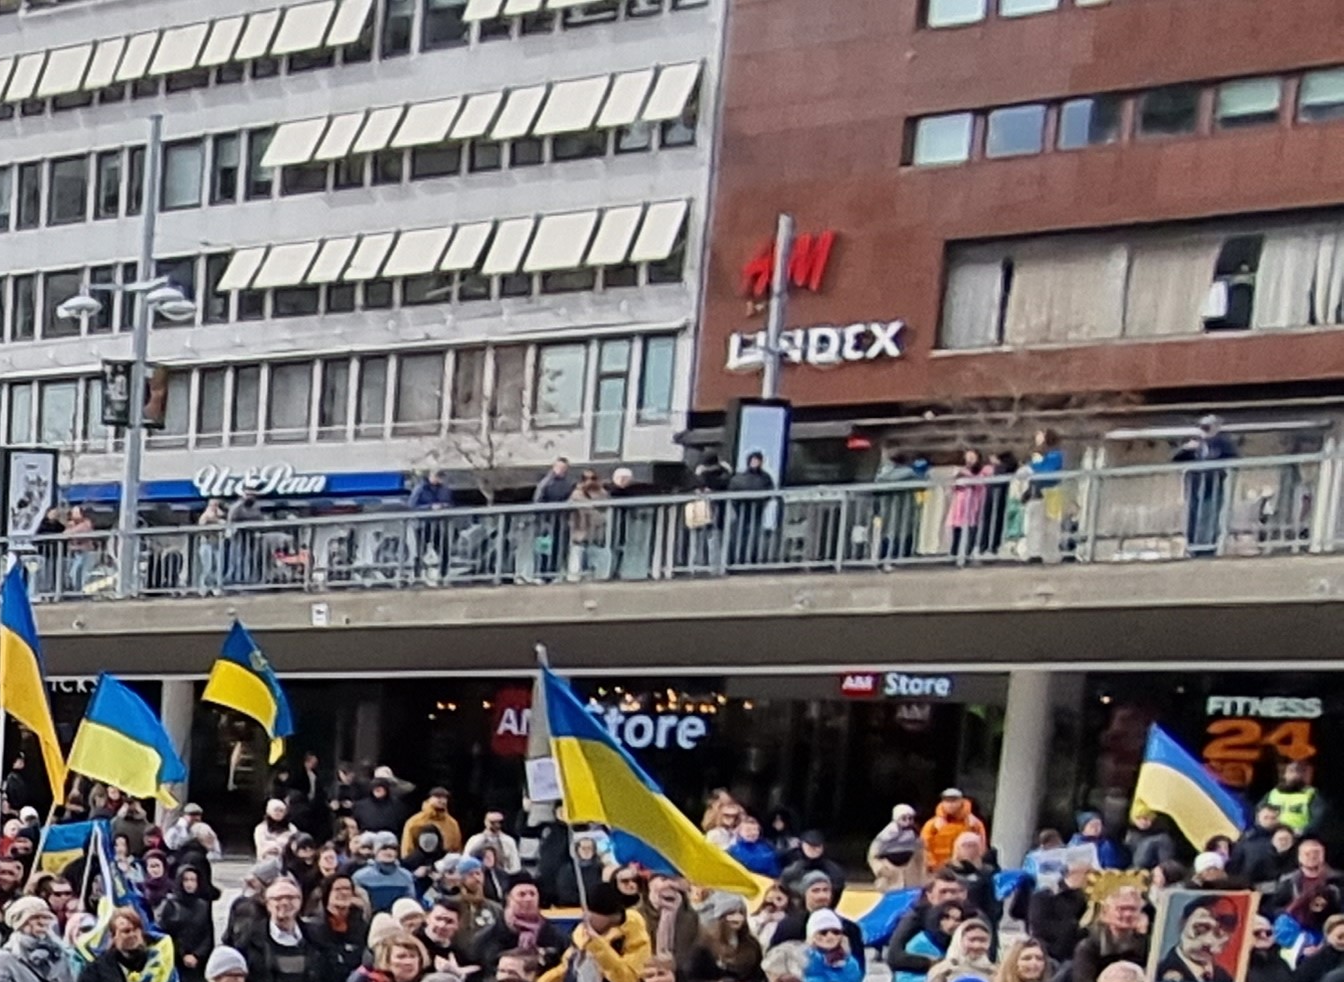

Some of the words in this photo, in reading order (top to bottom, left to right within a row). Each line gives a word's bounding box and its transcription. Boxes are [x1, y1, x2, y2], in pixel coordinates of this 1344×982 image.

[884, 672, 951, 696] Store
[1205, 696, 1323, 719] FITNESS
[1202, 719, 1317, 760] 24
